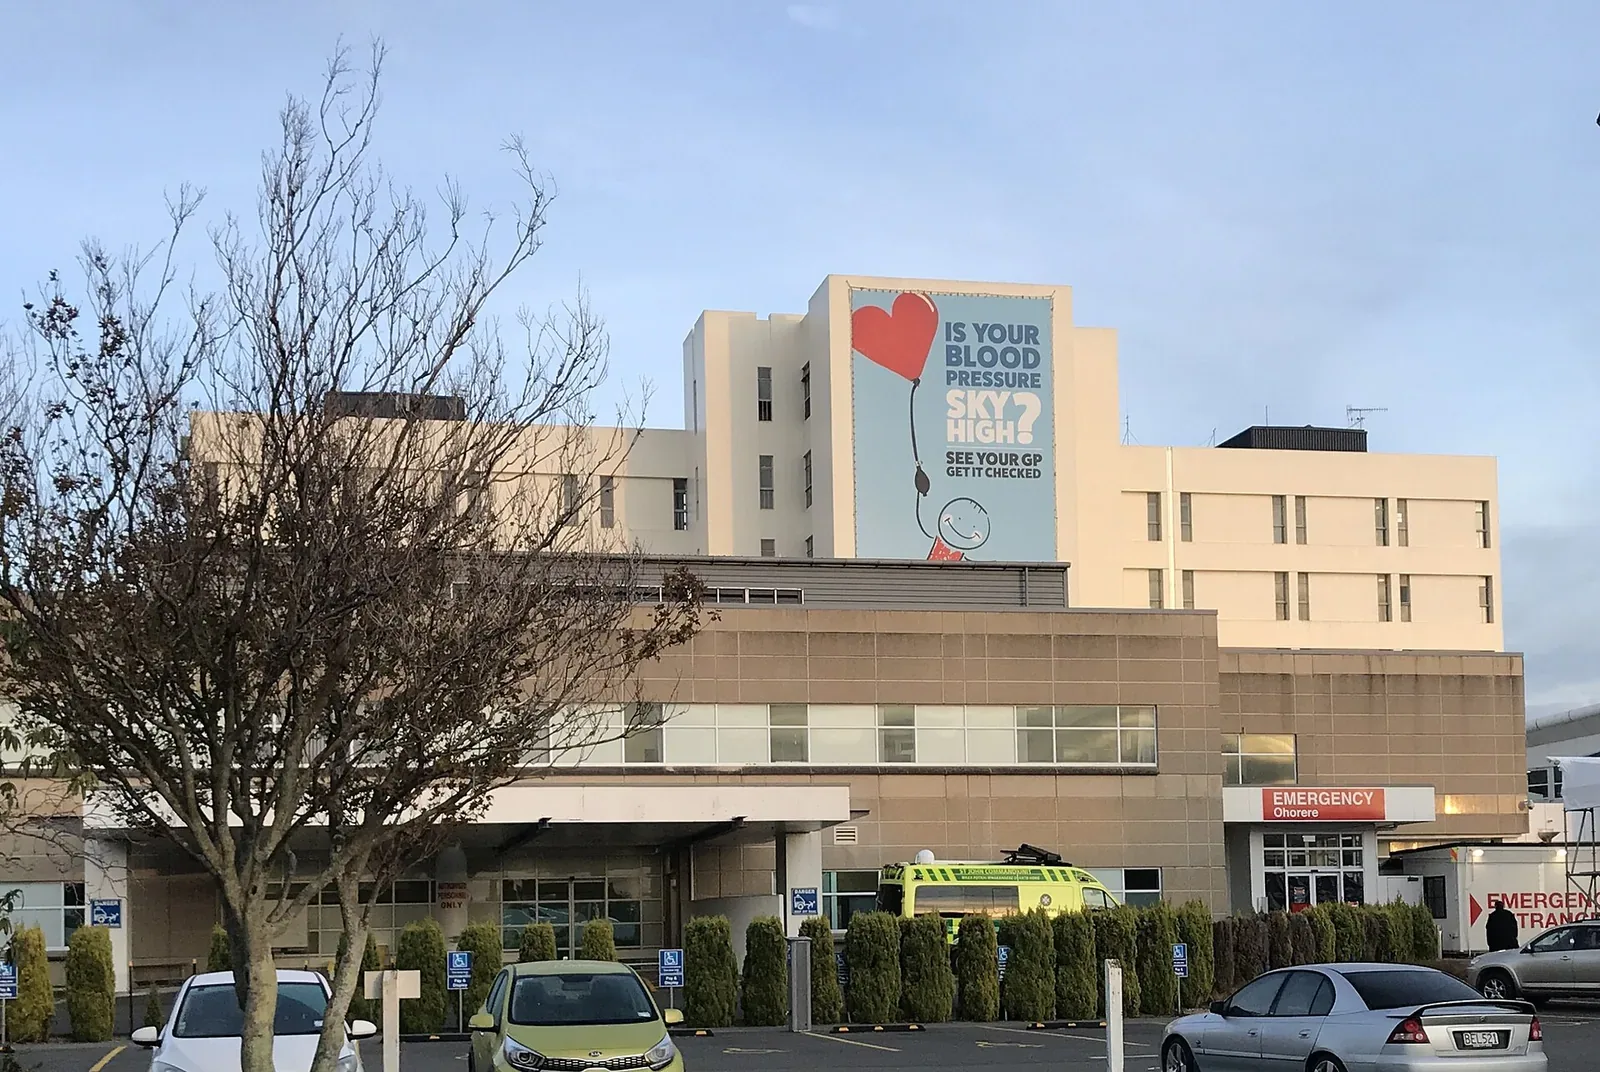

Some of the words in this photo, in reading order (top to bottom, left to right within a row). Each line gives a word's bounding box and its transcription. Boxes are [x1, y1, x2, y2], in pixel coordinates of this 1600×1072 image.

[945, 322, 967, 342] IS
[971, 323, 1040, 345] YOUR
[945, 344, 1041, 369] BLOOD
[946, 370, 1041, 388] PRESSURE
[945, 451, 974, 465] SEE
[976, 452, 1019, 466] YOUR
[1021, 453, 1043, 467] GP
[946, 466, 971, 477] GET
[971, 467, 984, 478] IT
[985, 468, 1042, 479] CHECKED
[1273, 791, 1374, 805] EMERGENCY
[1273, 807, 1319, 818] Ohorere
[440, 901, 463, 909] ONLY
[1464, 1032, 1498, 1045] BEL521
